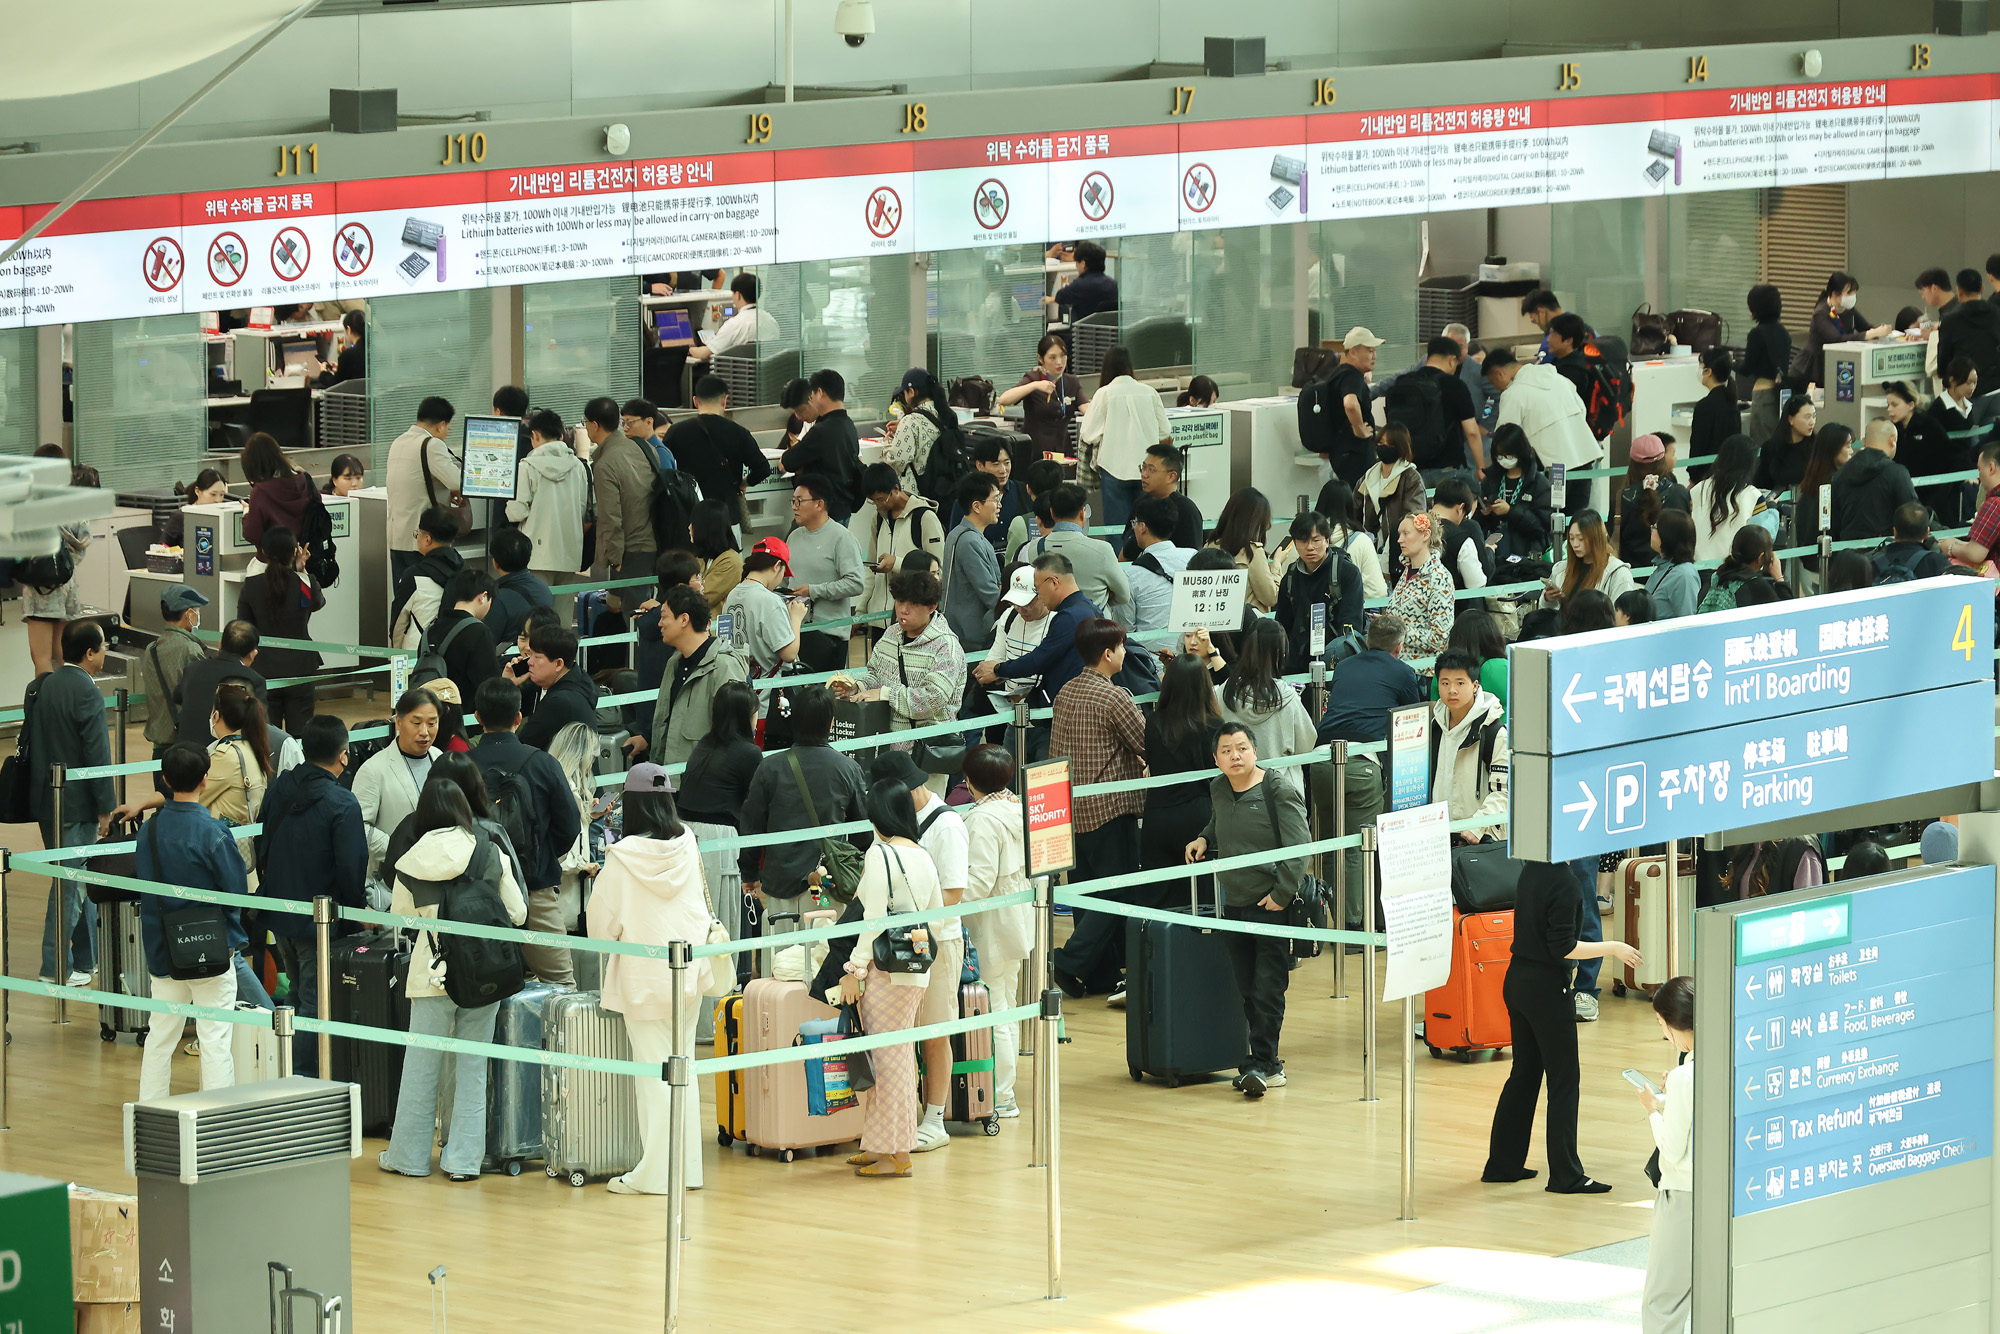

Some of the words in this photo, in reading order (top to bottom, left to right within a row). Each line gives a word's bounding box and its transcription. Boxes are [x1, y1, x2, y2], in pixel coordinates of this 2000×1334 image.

[1687, 56, 1709, 83] J4
[1911, 43, 1931, 70] J3
[1558, 63, 1582, 91] J5
[1171, 87, 1196, 115] J7
[1312, 78, 1337, 106] J6
[1730, 91, 1772, 112] 기내반입
[1775, 87, 1828, 109] 리튬건전지
[1831, 85, 1863, 106] 허용량
[1865, 84, 1886, 104] 안내
[747, 113, 773, 144] J9
[902, 103, 928, 133] J8
[1360, 114, 1407, 136] 기내반입
[1410, 110, 1467, 133] 리튬건전지
[1470, 107, 1505, 128] 허용량
[1508, 105, 1531, 126] 안내
[275, 143, 318, 177] J11
[442, 131, 487, 165] J10
[986, 139, 1012, 162] 위탁
[1015, 137, 1053, 160] 수하물
[1057, 135, 1081, 157] 금지
[1085, 134, 1110, 155] 품목
[1320, 164, 1348, 175] Lithium
[1350, 162, 1380, 173] batteries
[1382, 160, 1397, 170] with
[1399, 159, 1422, 168] 100Wh
[1432, 157, 1446, 166] less
[1447, 157, 1462, 167] may
[1463, 155, 1472, 164] be
[1473, 153, 1500, 164] allowed
[1502, 152, 1508, 161] in
[1540, 149, 1569, 160] baggage
[509, 171, 564, 196] 기내반입
[569, 166, 638, 191] 리튬건전지
[642, 163, 683, 186] 허용량
[686, 160, 713, 183] 안내
[205, 199, 228, 217] 위탁
[230, 197, 264, 216] 수하물
[266, 194, 289, 212] 금지
[291, 193, 314, 210] 품목
[461, 210, 502, 226] 위탁수하물
[523, 209, 551, 220] 100Wh
[553, 206, 568, 218] 이내
[570, 204, 616, 217] 기내반입가능
[461, 227, 494, 239] Lithium
[496, 224, 533, 236] batteries
[535, 222, 554, 233] with
[556, 220, 584, 231] 100Wh
[585, 221, 595, 229] or
[596, 218, 613, 229] less
[614, 218, 631, 229] may
[634, 216, 645, 226] be
[646, 213, 678, 225] allowed
[680, 212, 688, 222] in
[689, 210, 724, 223] carry-on
[726, 208, 760, 221] baggage
[13, 264, 52, 277] baggage
[1182, 576, 1213, 586] MU580
[1222, 574, 1240, 585] NKG
[1194, 603, 1205, 612] 12
[1216, 602, 1226, 611] 15
[1951, 604, 1976, 661] 4
[1603, 658, 1713, 713] 국제선탑승
[1766, 663, 1851, 700] Boarding
[836, 720, 856, 729] Locker
[1615, 774, 1640, 824] P
[1658, 760, 1731, 811] 주차장
[1742, 772, 1813, 810] Parking
[1029, 803, 1045, 815] SKY
[1029, 808, 1067, 825] PRIORITY
[177, 933, 218, 944] KANGOL
[1790, 962, 1823, 988] 화장실
[1828, 969, 1857, 986] Toilets
[1818, 1010, 1839, 1034] 음료
[1844, 1016, 1869, 1034] Food,
[1871, 1009, 1915, 1029] Beverages
[1789, 1065, 1812, 1089] 환전
[1816, 1070, 1855, 1089] Currency
[1858, 1060, 1900, 1080] Exchange
[1790, 1118, 1814, 1140] Tax
[1817, 1103, 1863, 1134] Refund
[1790, 1168, 1800, 1190] 큰
[1804, 1165, 1814, 1187] 짐
[1818, 1158, 1848, 1182] 부치는
[1852, 1154, 1862, 1175] 곳
[1868, 1154, 1906, 1177] Oversized
[1907, 1149, 1941, 1168] Baggage
